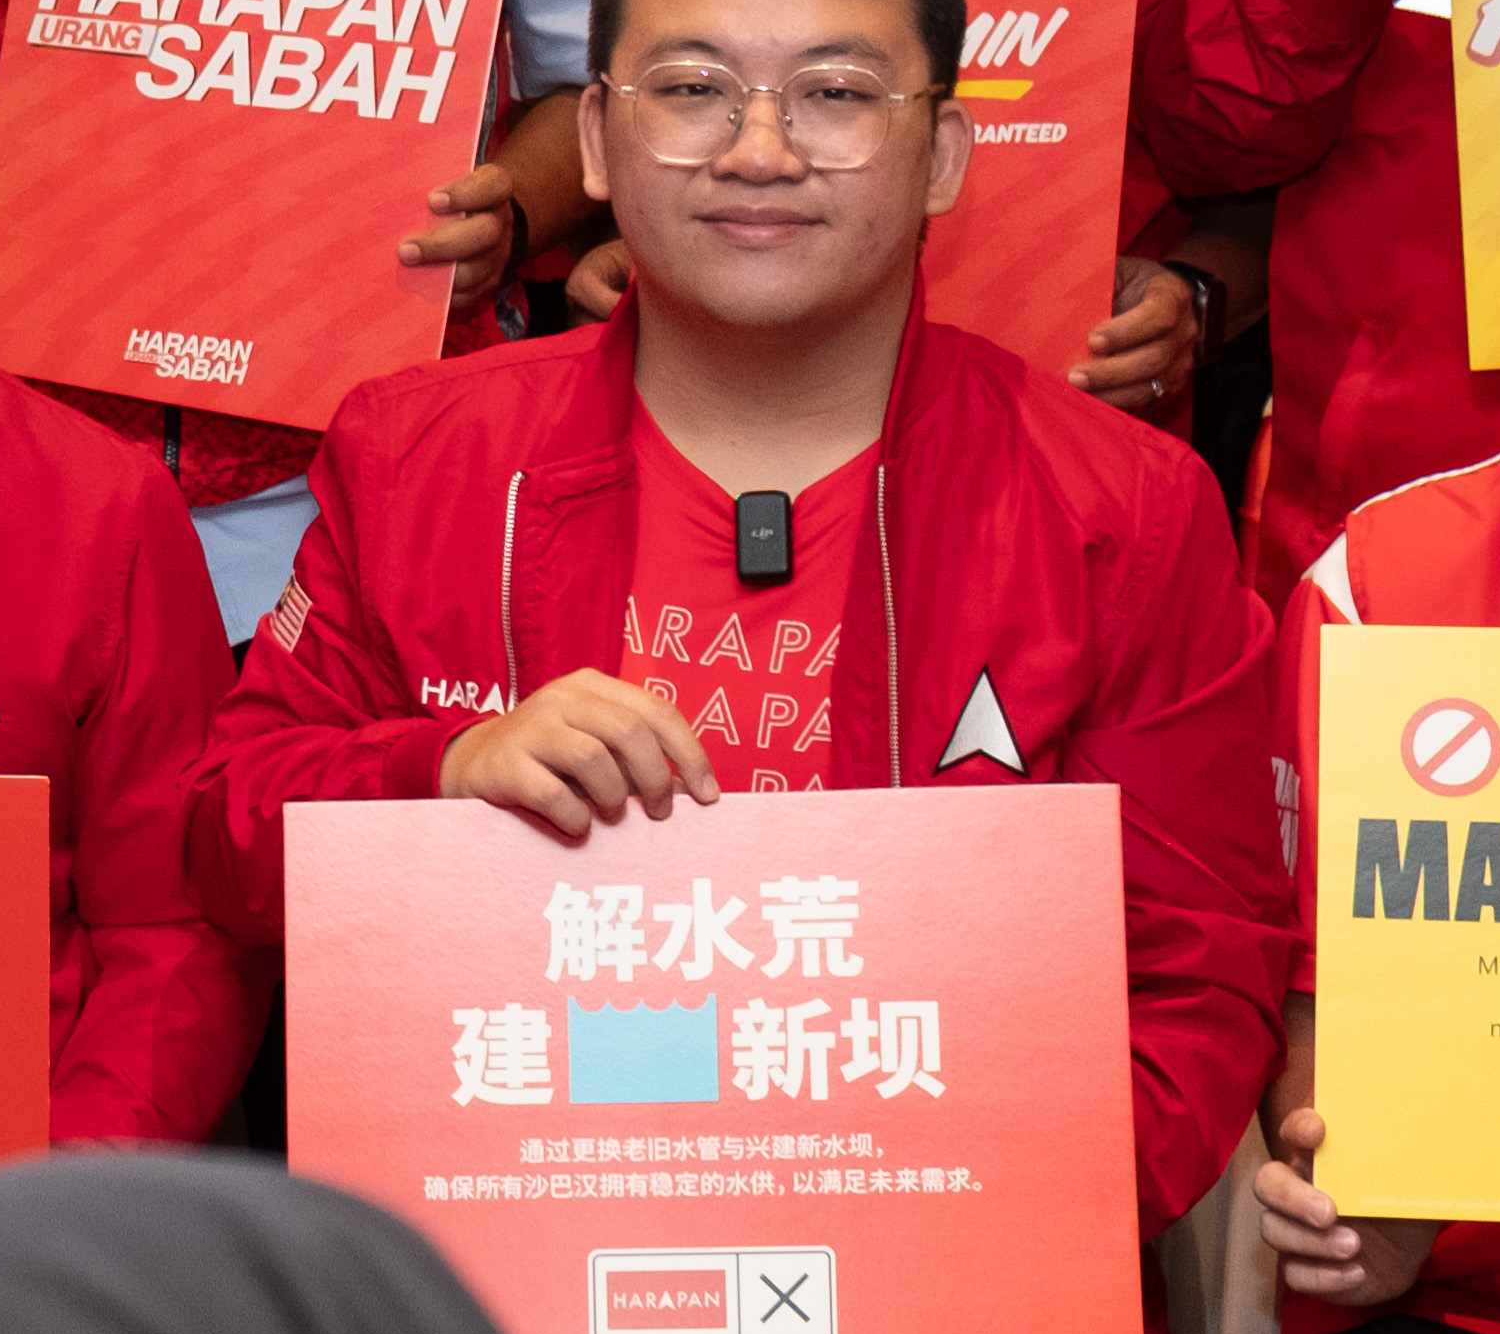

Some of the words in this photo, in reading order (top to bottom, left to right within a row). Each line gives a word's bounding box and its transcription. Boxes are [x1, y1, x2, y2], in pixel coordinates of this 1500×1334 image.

[40, 18, 142, 52] URANG
[136, 24, 456, 125] SABAH
[127, 328, 254, 364] HARAPAN
[155, 354, 249, 385] SABAH
[543, 876, 865, 983] 解水荒
[452, 1004, 554, 1106] 建
[732, 999, 947, 1103] 新坝
[612, 1288, 720, 1310] HARAPAN
